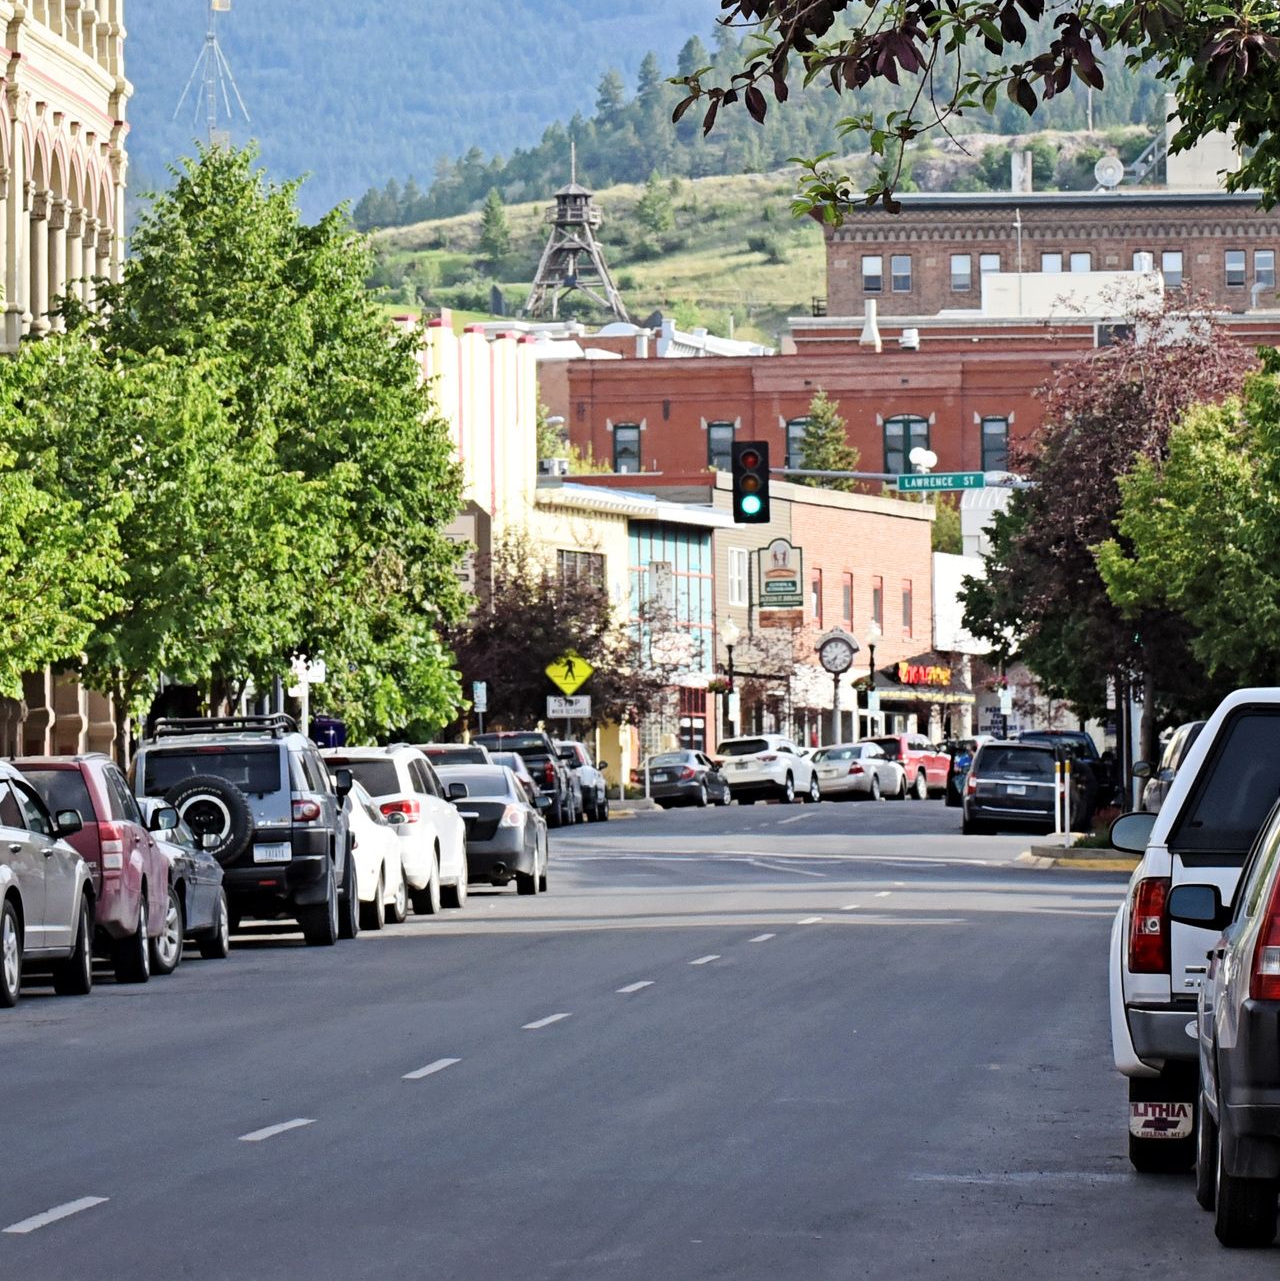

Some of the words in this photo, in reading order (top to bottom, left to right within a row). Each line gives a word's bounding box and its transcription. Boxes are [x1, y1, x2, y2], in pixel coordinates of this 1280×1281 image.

[905, 477, 953, 487] LAWRENCE
[963, 476, 974, 485] ST
[1133, 1103, 1188, 1117] LITHIA
